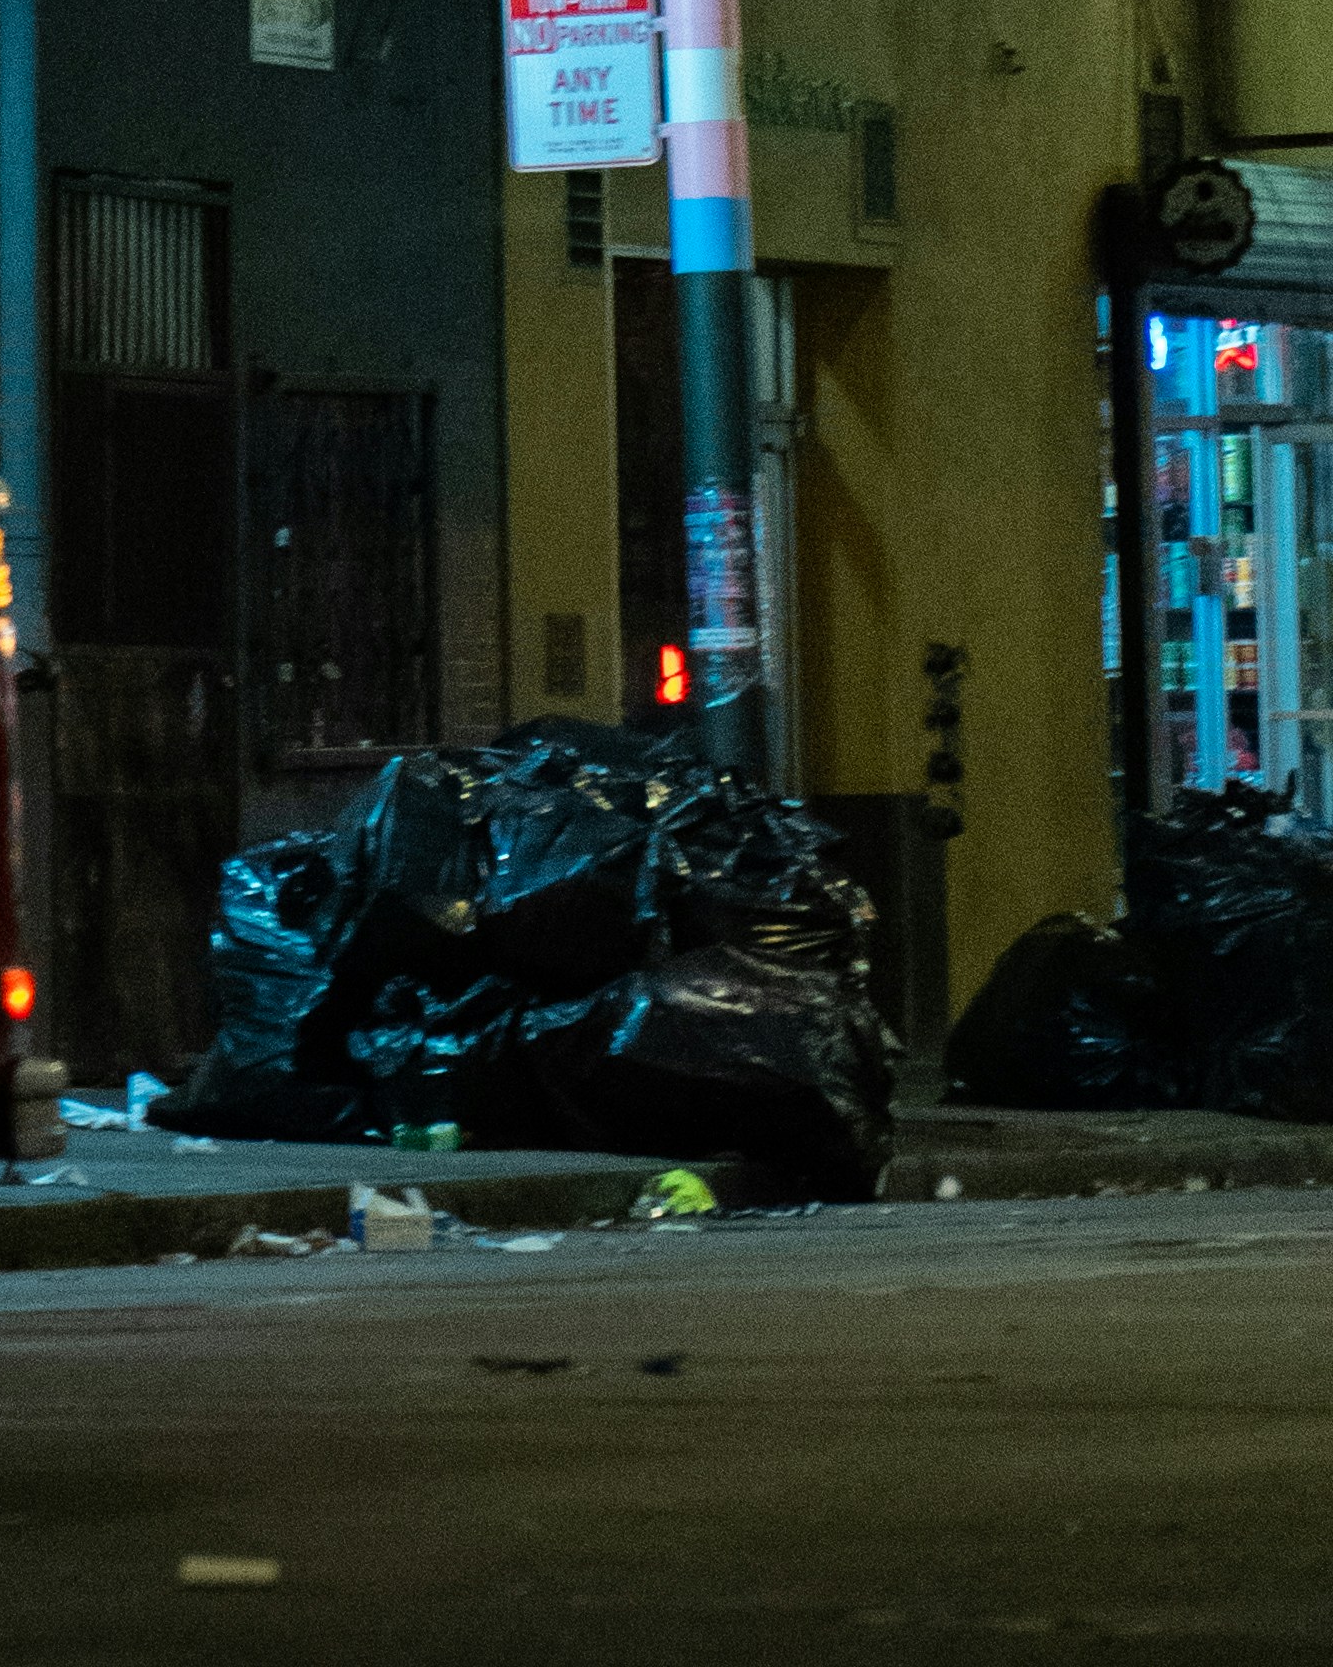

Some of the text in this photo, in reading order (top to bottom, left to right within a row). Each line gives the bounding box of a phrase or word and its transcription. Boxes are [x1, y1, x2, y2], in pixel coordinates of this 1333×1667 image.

[511, 16, 651, 53] NO PARKING
[551, 65, 613, 94] ANY
[548, 98, 621, 127] TIME
